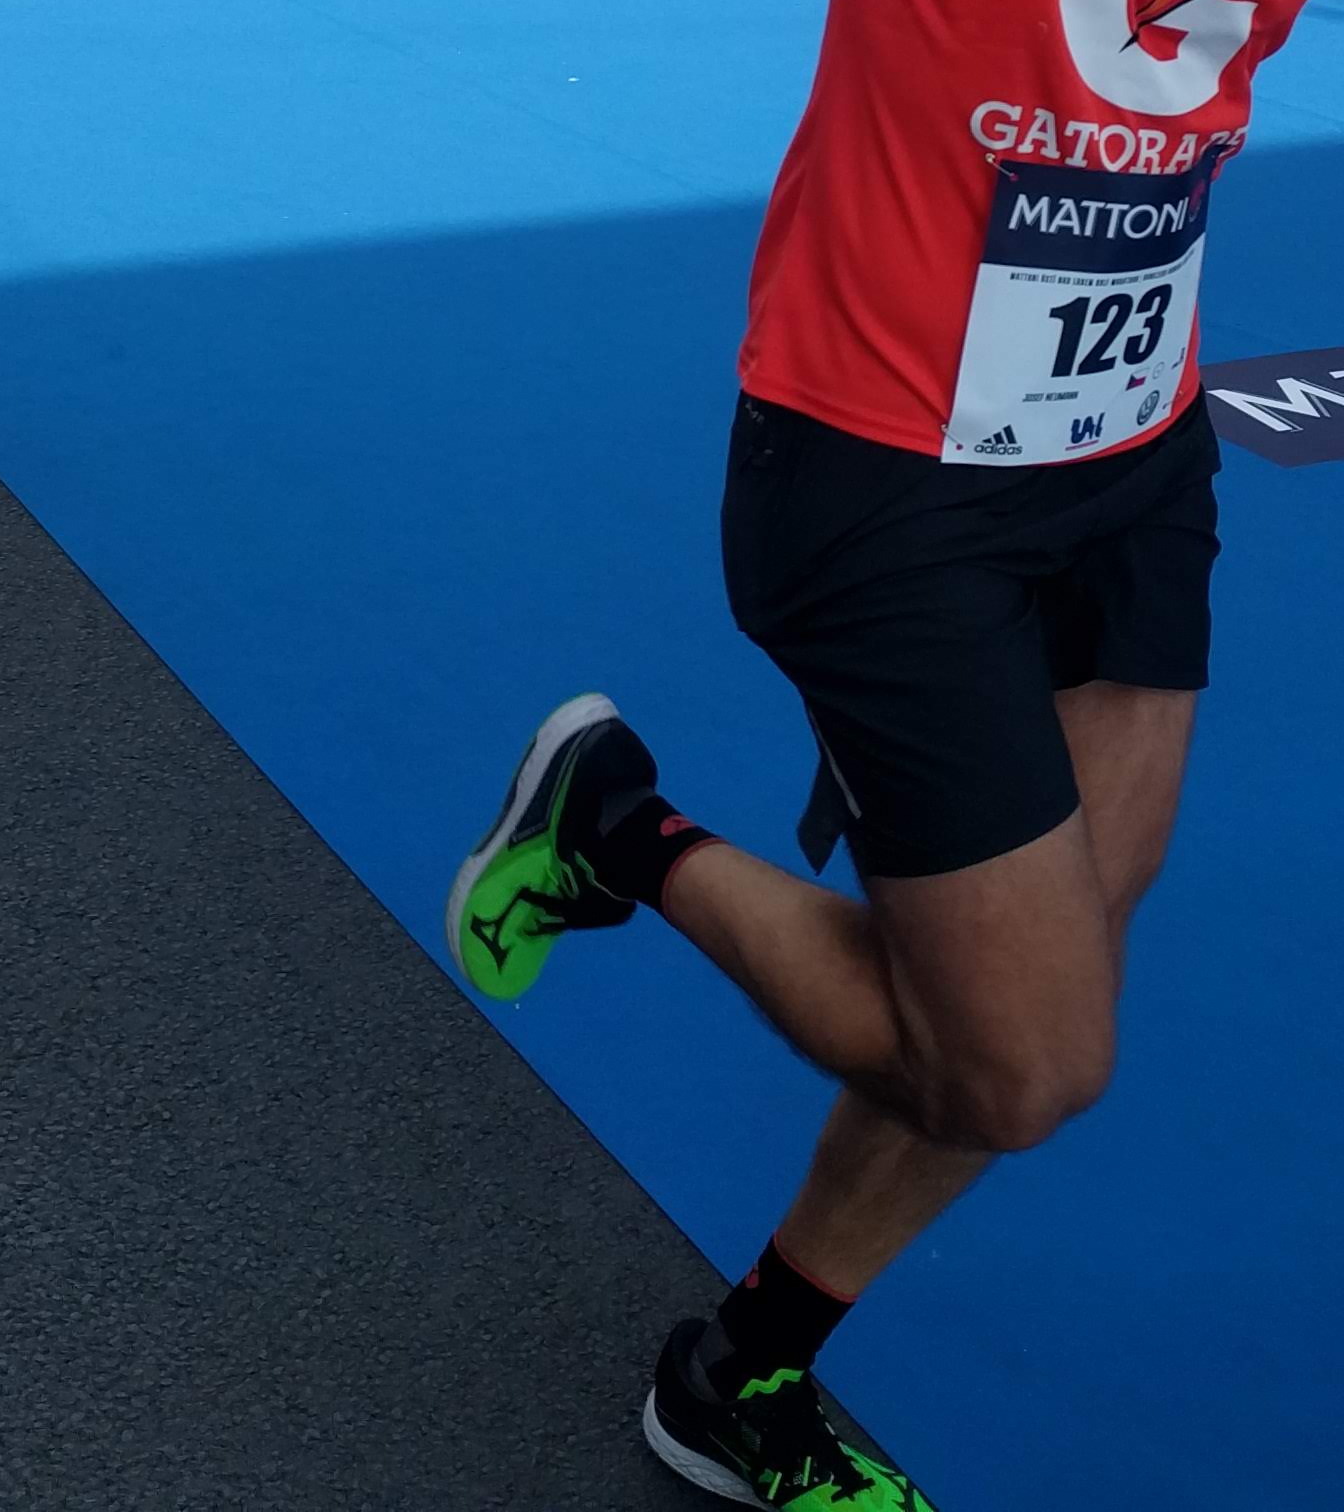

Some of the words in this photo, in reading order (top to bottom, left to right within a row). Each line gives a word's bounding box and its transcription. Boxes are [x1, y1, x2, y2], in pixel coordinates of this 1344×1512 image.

[1008, 193, 1189, 240] MATTONI
[1048, 282, 1174, 379] 123
[973, 442, 1024, 456] adidas
